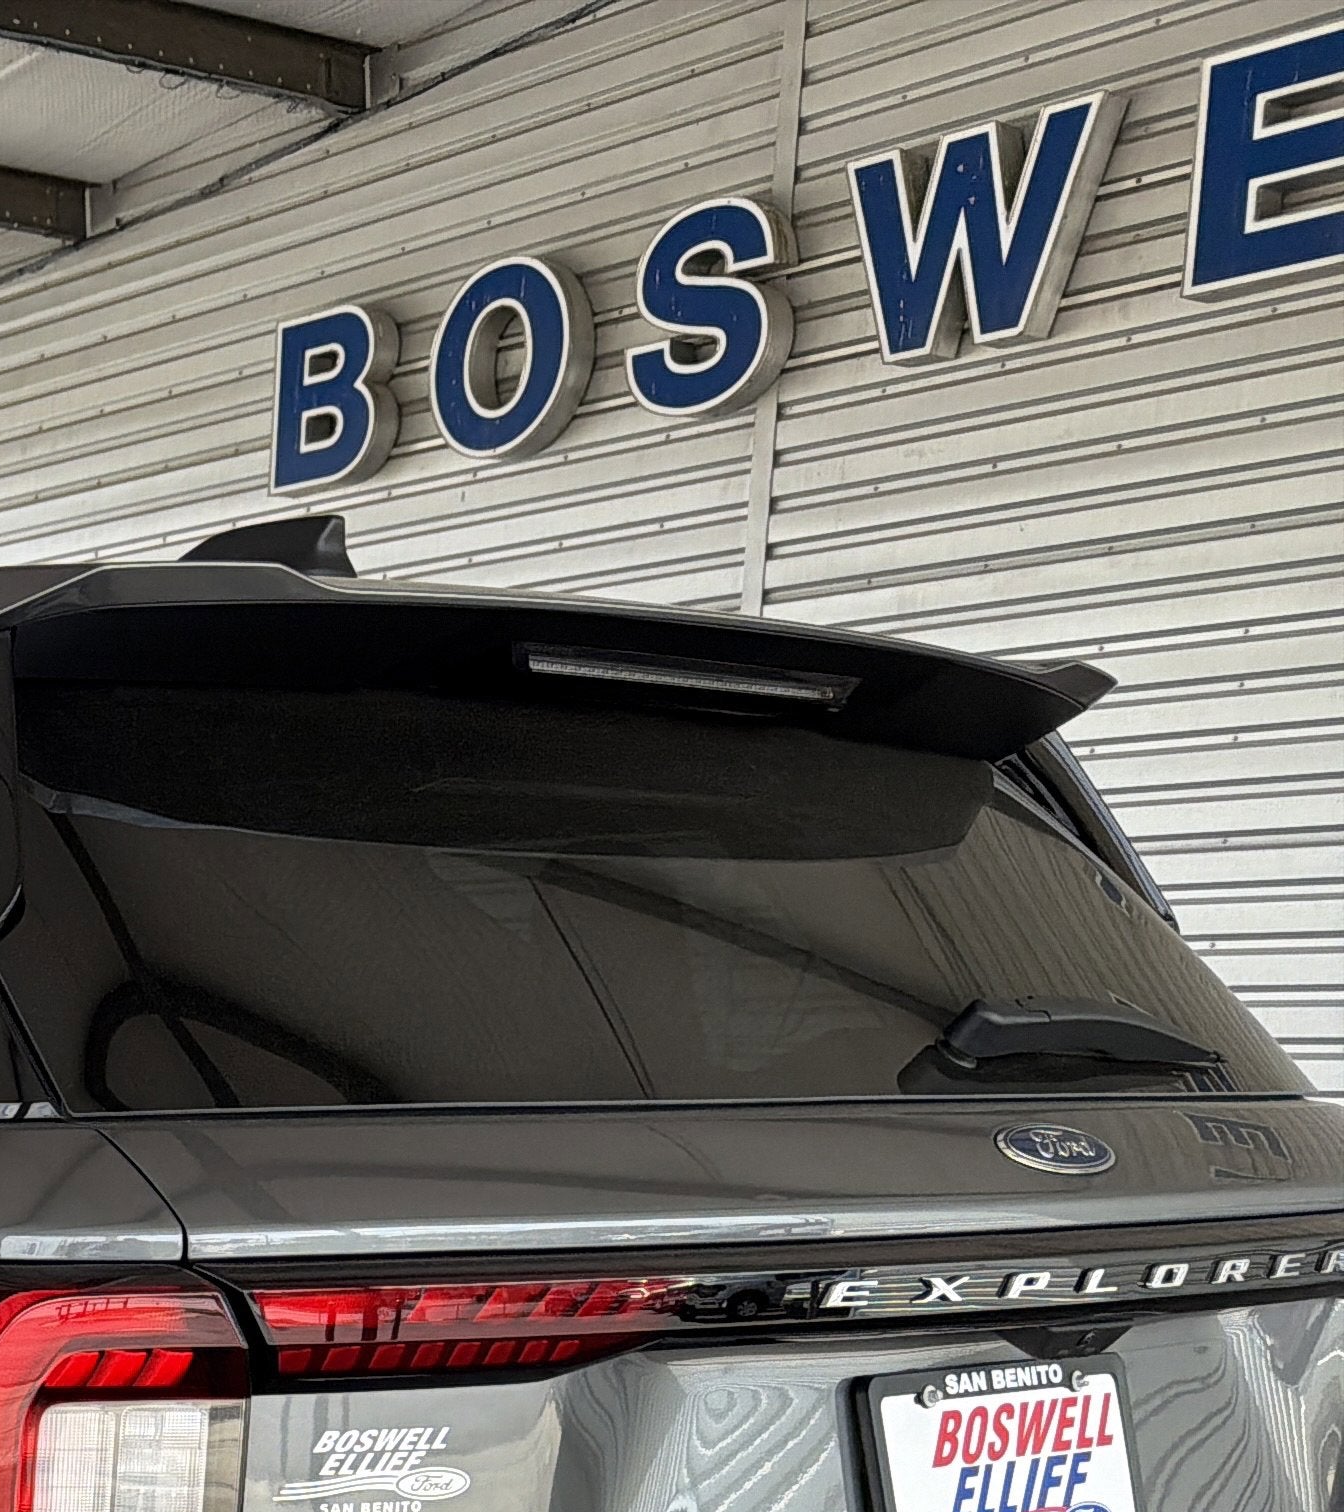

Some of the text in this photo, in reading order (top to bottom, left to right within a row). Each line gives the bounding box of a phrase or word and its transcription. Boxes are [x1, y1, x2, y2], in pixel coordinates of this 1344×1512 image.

[269, 23, 1344, 496] BOSWE
[1029, 1128, 1096, 1158] Ford
[945, 1364, 1062, 1394] SAN BENITO
[313, 1427, 450, 1453] BOSWELL
[932, 1393, 1113, 1468] BOSWELL
[319, 1451, 426, 1476] ELLIFF
[411, 1475, 453, 1492] Ford
